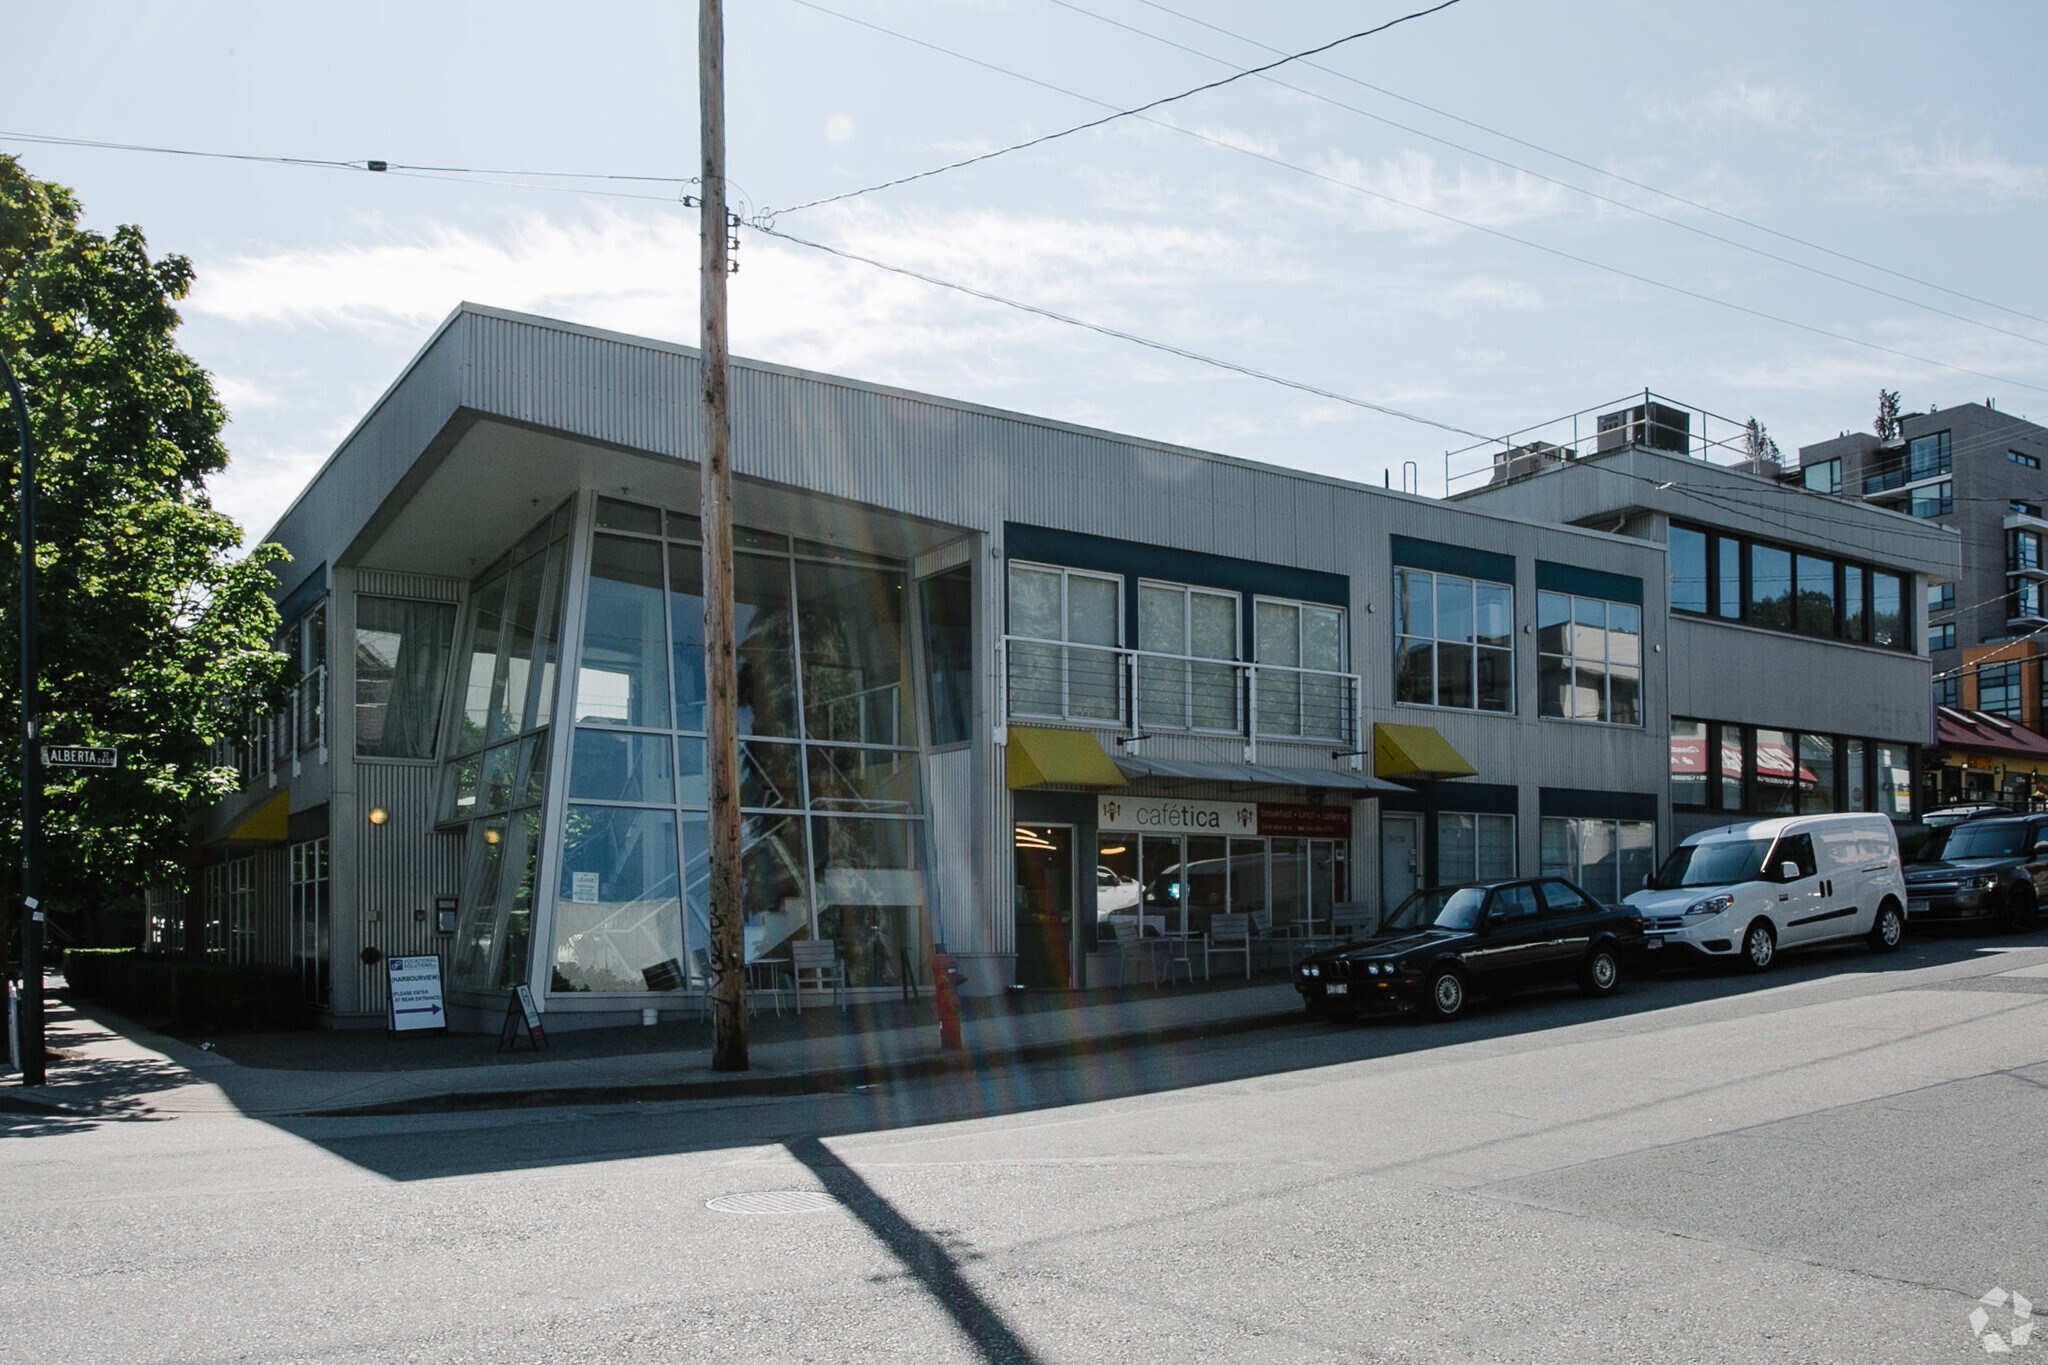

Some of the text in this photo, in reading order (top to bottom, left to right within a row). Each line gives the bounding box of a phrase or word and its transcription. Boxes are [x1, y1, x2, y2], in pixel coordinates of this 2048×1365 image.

[50, 749, 96, 763] ALBERTA
[1136, 803, 1220, 828] cafética
[1260, 808, 1293, 819] breakfast
[1298, 809, 1316, 819] lunch
[391, 975, 440, 984] (HARBOURVIEW)
